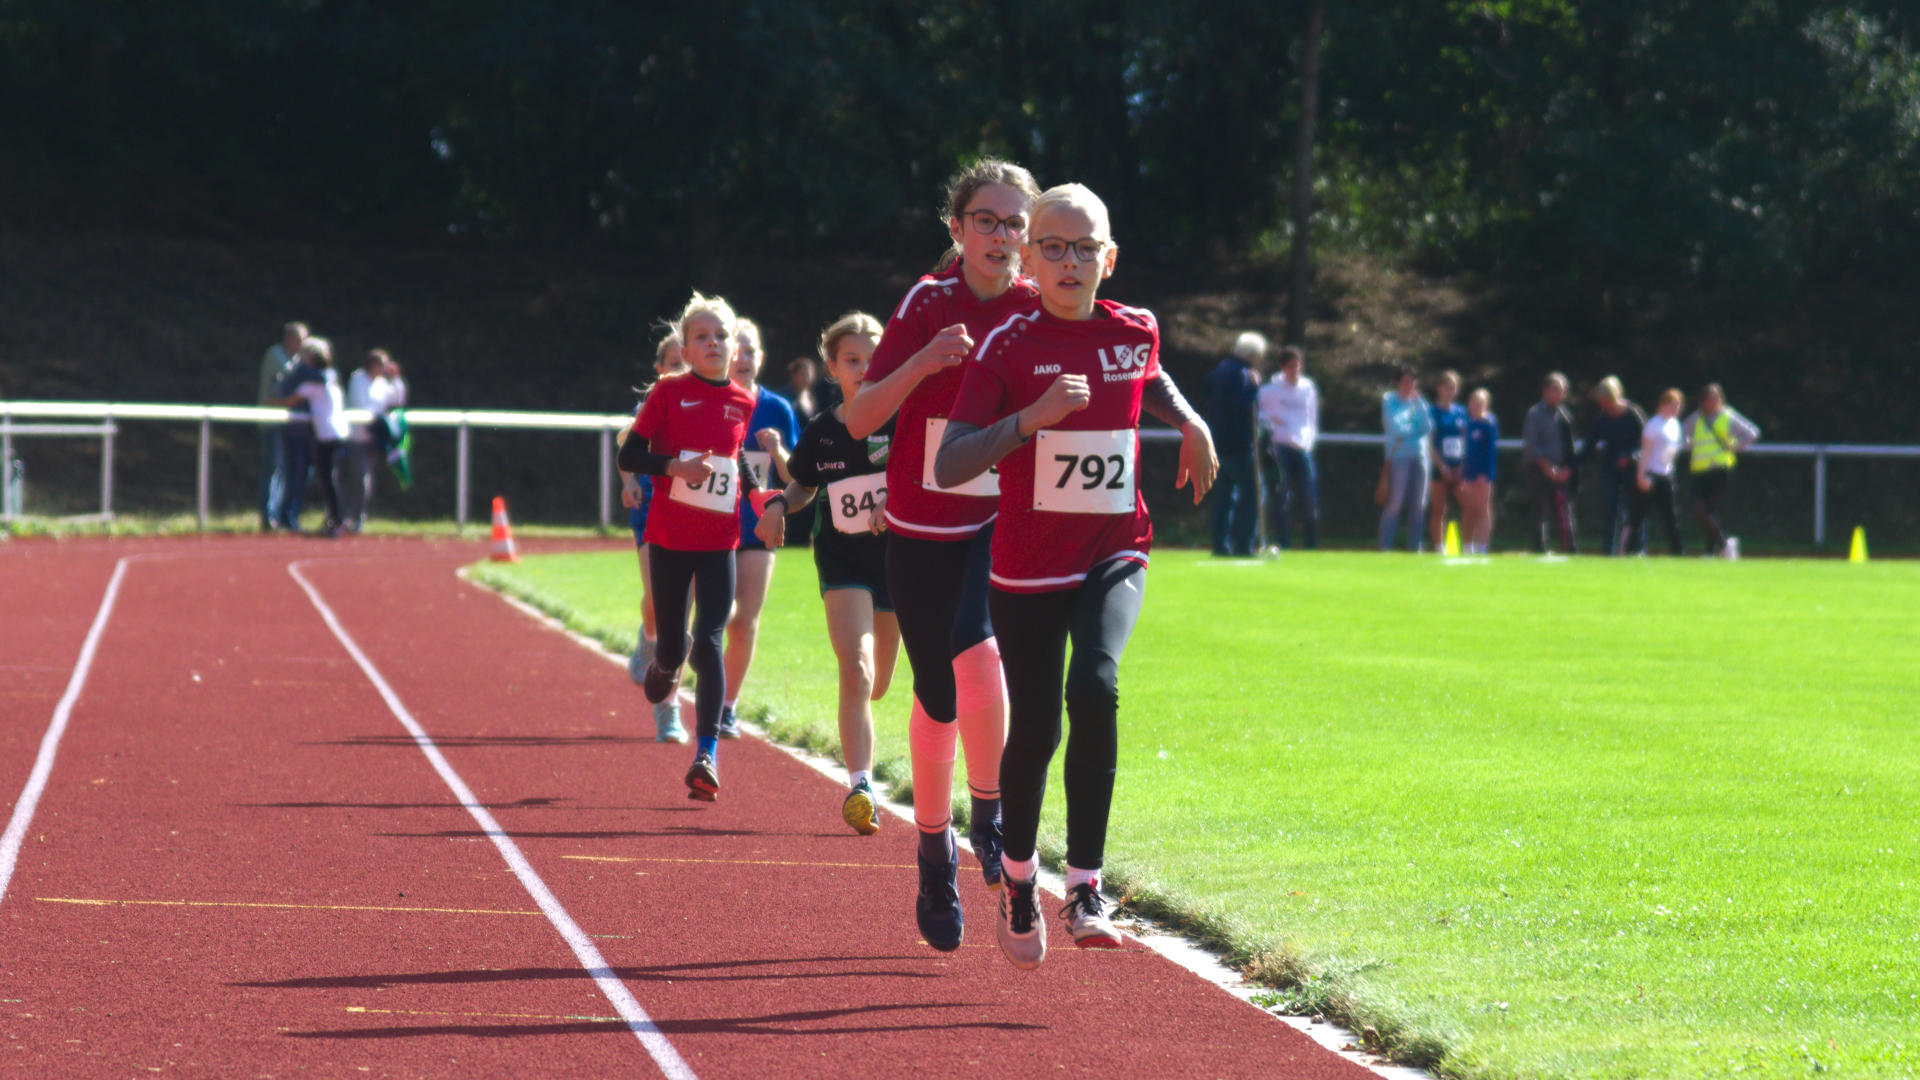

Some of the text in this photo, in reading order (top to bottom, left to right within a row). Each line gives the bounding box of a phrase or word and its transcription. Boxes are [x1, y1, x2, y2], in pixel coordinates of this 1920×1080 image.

[1033, 364, 1061, 375] JAKO
[816, 461, 846, 471] Laura
[1054, 453, 1125, 490] 792
